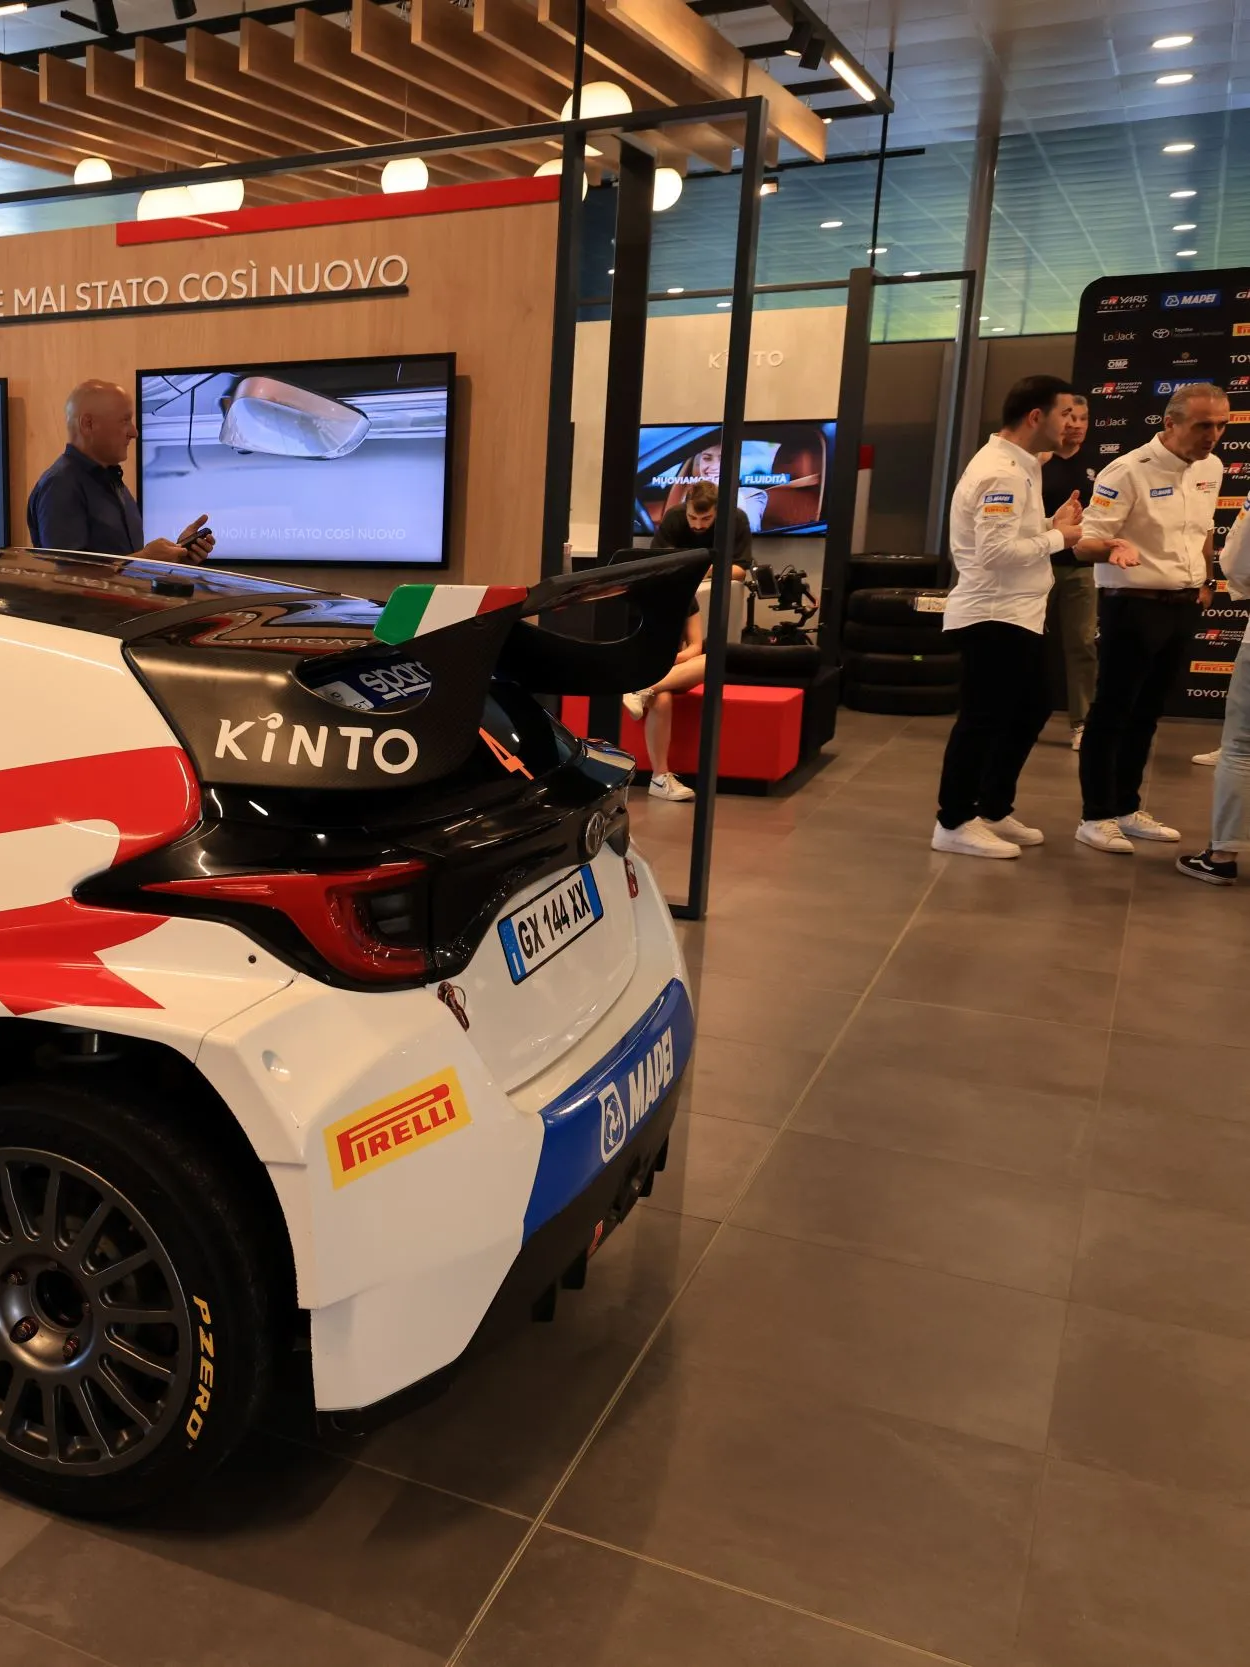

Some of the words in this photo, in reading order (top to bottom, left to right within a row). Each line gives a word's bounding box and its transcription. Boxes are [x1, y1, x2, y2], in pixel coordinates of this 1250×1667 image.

[14, 284, 66, 315] MAI
[76, 276, 170, 312] STATO
[178, 260, 258, 304] COSÌ
[270, 254, 409, 297] NUOVO
[1120, 294, 1149, 304] YARIS
[1180, 293, 1218, 305] MAPEI
[708, 349, 784, 369] KTO
[744, 473, 788, 485] FLUIDITÀ
[284, 527, 322, 540] STATO
[325, 525, 354, 540] COSÌ
[358, 527, 406, 540] NUOVO
[1186, 688, 1228, 698] TOYOT
[478, 727, 536, 781] 4
[517, 912, 546, 960] GX
[543, 894, 571, 941] 144
[567, 879, 591, 924] XX
[627, 1026, 675, 1131] MAPEI
[336, 1083, 457, 1172] PIRELLI
